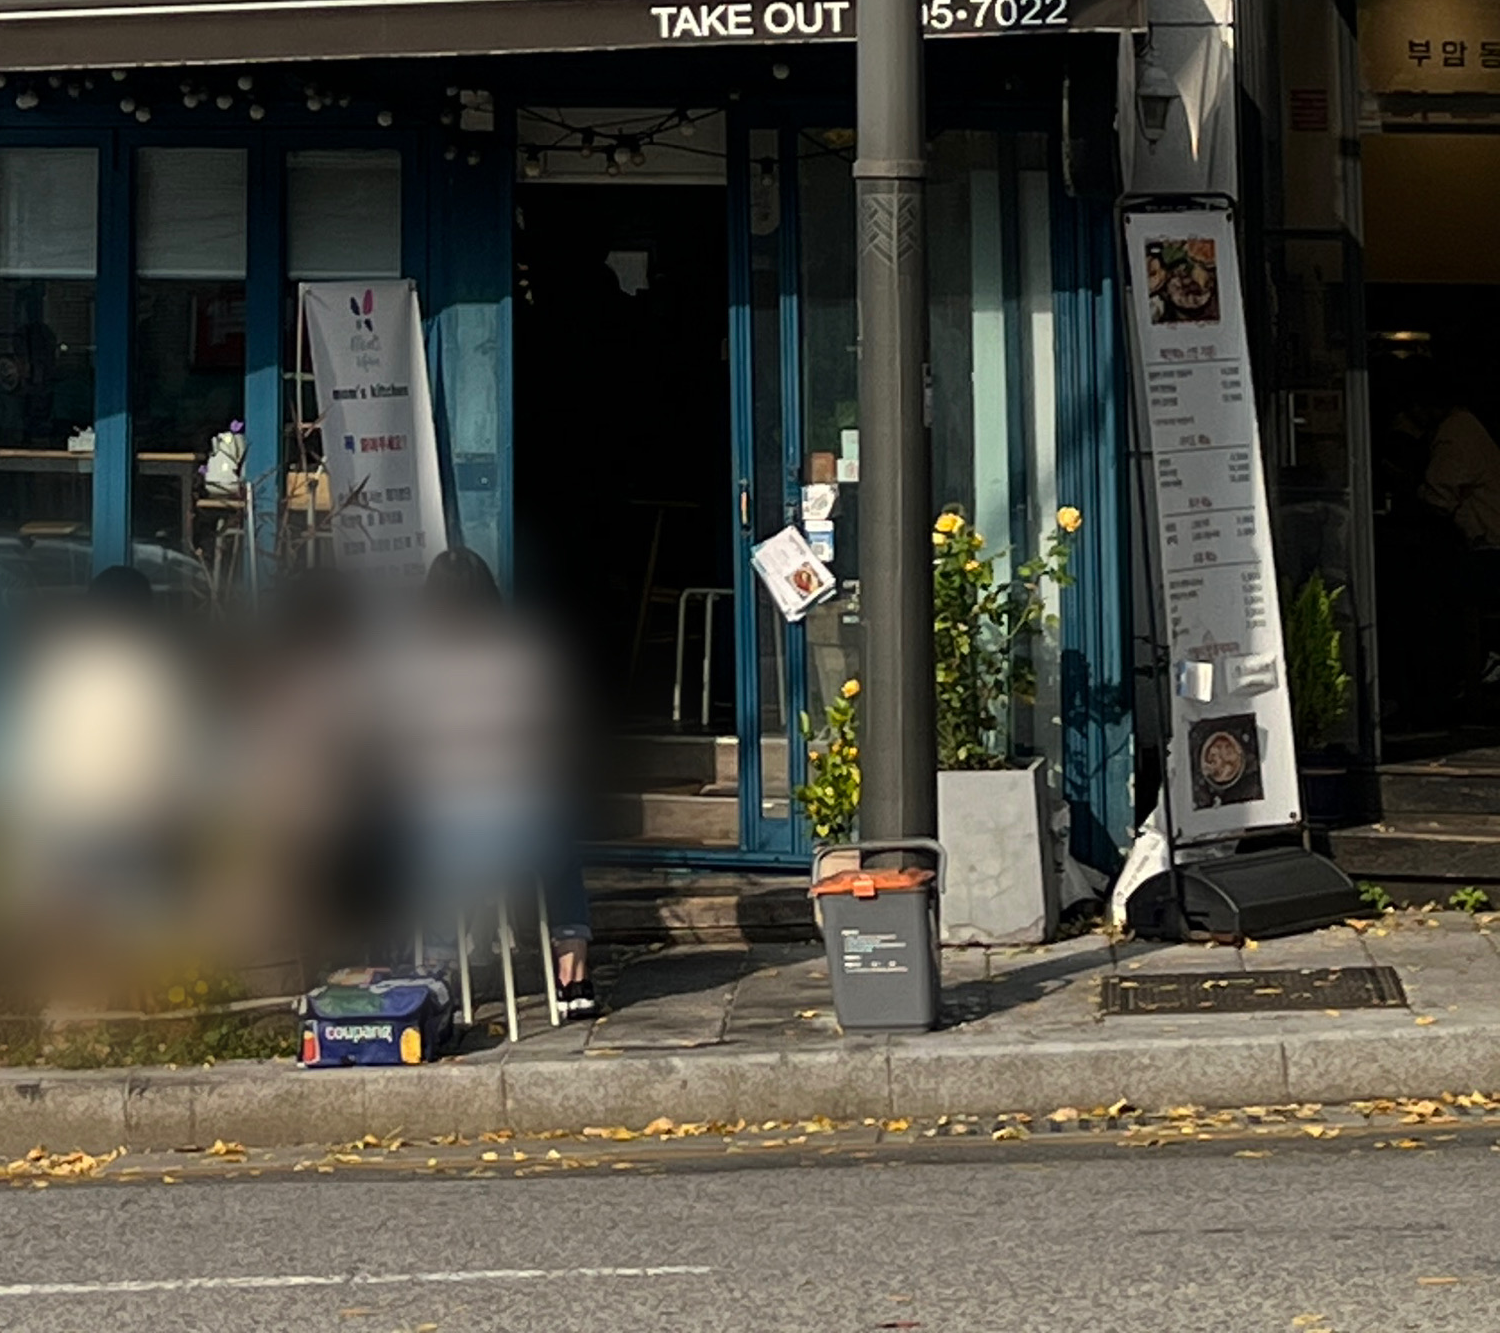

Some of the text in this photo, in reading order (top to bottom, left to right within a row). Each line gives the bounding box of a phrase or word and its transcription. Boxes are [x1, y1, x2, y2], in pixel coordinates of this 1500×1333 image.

[651, 3, 752, 38] TAKE
[763, 1, 850, 34] OUT
[325, 1024, 393, 1043] coupang
